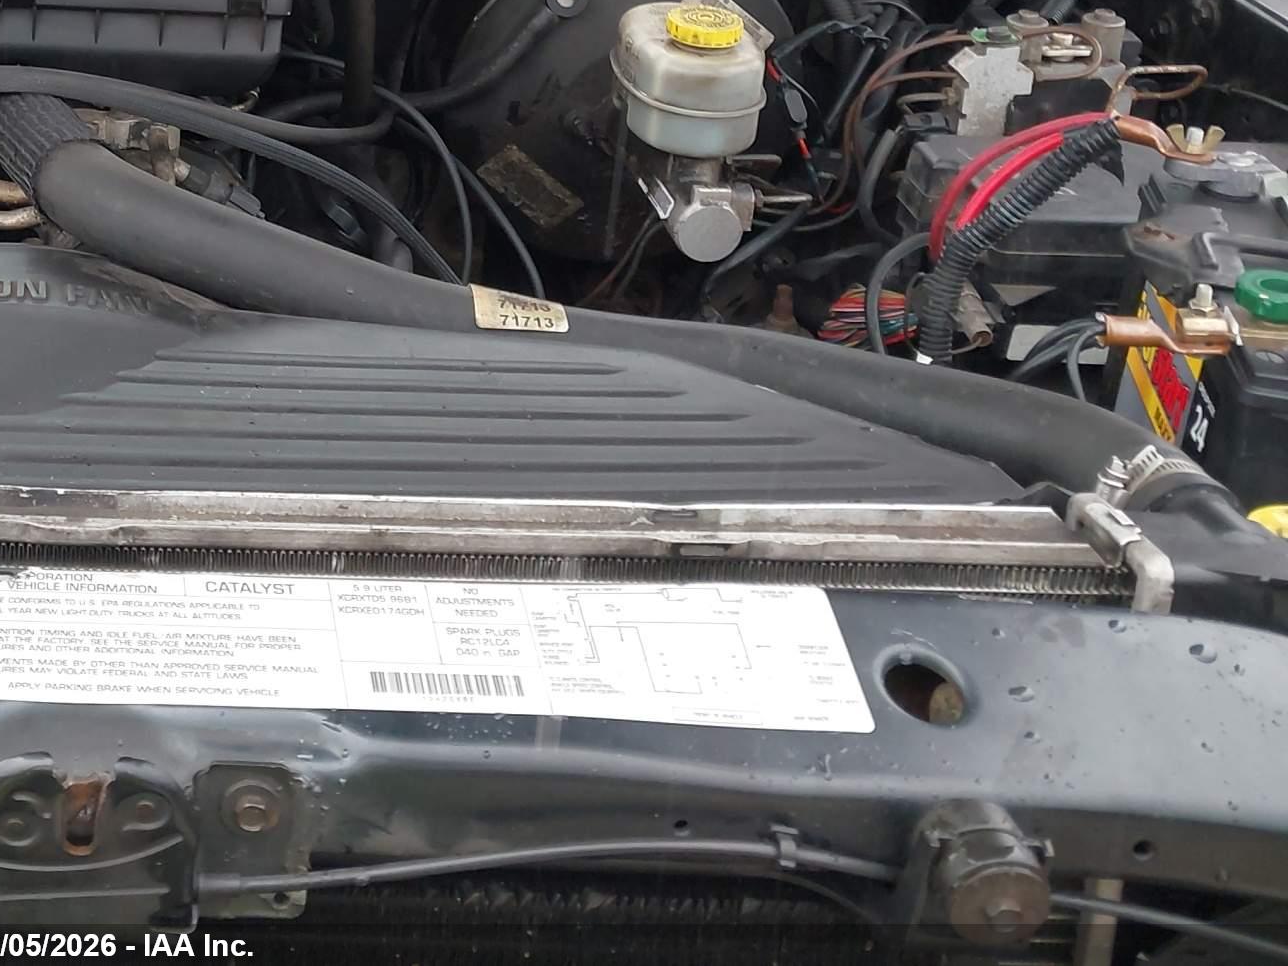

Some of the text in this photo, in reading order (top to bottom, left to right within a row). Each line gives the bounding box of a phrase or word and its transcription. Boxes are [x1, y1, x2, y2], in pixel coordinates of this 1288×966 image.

[65, 283, 153, 315] FAN
[499, 314, 555, 329] 71713
[7, 580, 61, 592] VEHICLE
[65, 582, 158, 594] INFORMATION
[204, 580, 296, 595] CATALYST
[374, 585, 402, 593] LITER
[462, 587, 479, 595] NO
[8, 596, 62, 606] CONFORMS
[65, 598, 76, 606] TO
[435, 597, 515, 607] ADJUSTMENTS
[7, 607, 33, 615] YEAR
[35, 608, 58, 616] NEW
[118, 610, 155, 619] TRUCKS
[454, 609, 499, 618] NEEDED
[39, 628, 76, 637] TIMING
[79, 630, 103, 638] AND
[186, 633, 232, 642] MIXTURE
[236, 635, 265, 643] HAVE
[268, 635, 297, 643] BEEN
[29, 644, 52, 652] AND
[55, 645, 90, 653] OTHER
[90, 638, 111, 646] SEE
[114, 639, 135, 647] THE
[137, 640, 180, 648] SERVICE
[184, 641, 231, 650] MANUAL
[234, 642, 256, 650] FOR
[37, 658, 69, 667] MADE
[72, 659, 87, 667] BY
[90, 660, 126, 668] OTHER
[129, 661, 160, 670] THAN
[163, 662, 221, 672] APPROVED
[223, 664, 268, 673] SERVICE
[272, 665, 319, 674] MANUAL
[29, 666, 54, 674] MAY
[57, 667, 99, 676] VIOLATE
[102, 668, 148, 677] FEDERAL
[154, 669, 178, 678] AND
[181, 670, 212, 679] STATE
[7, 681, 41, 690] APPLY
[44, 682, 93, 692] PARKING
[96, 684, 132, 693] BRAKE
[137, 685, 172, 694] WHEN
[175, 686, 233, 695] SERVICING
[236, 687, 280, 697] VEHICLE
